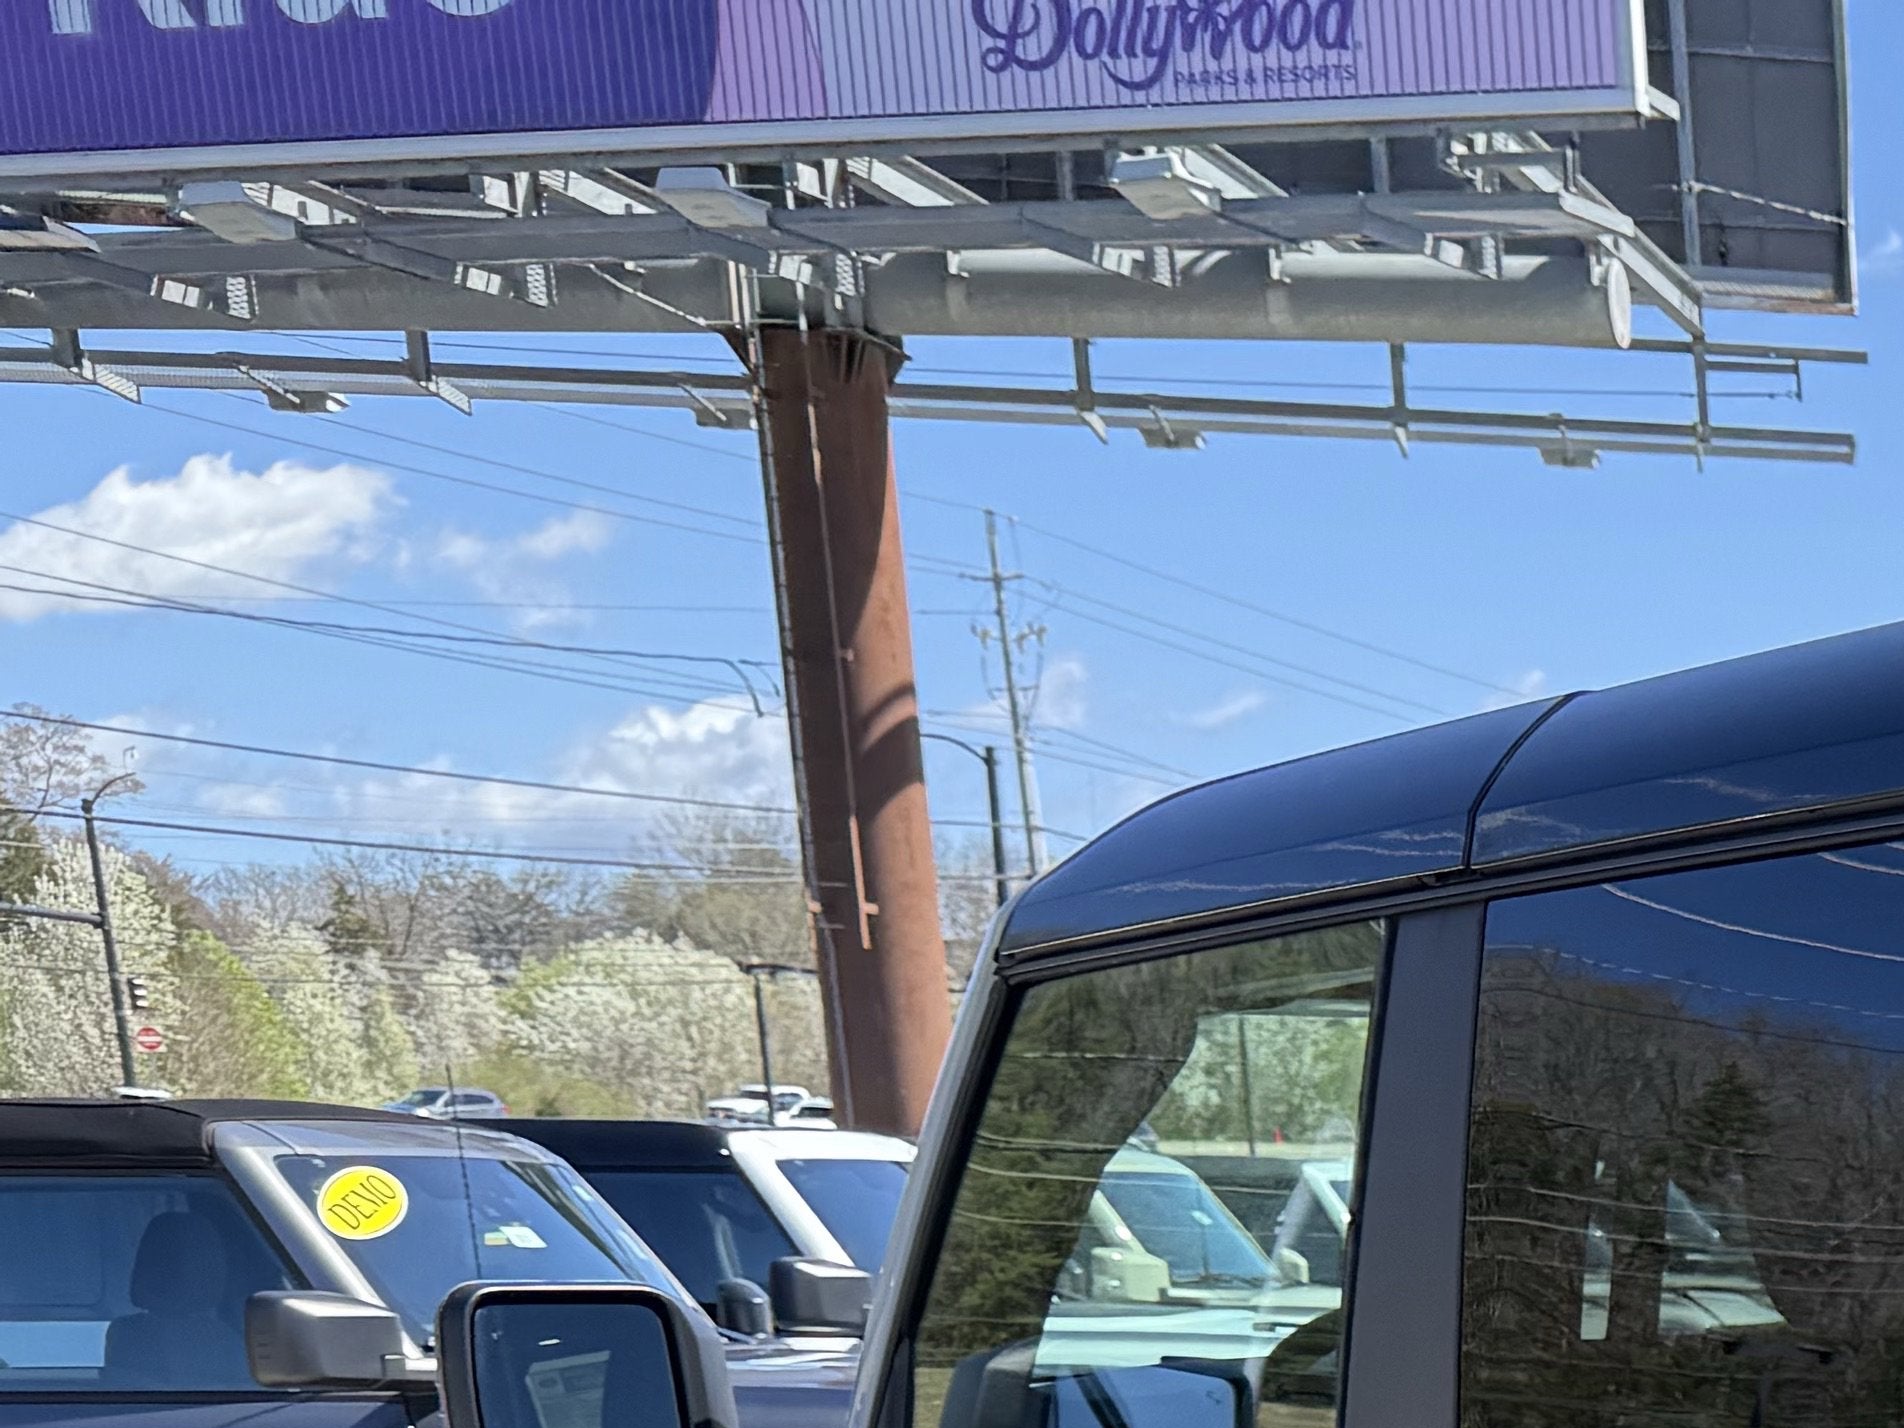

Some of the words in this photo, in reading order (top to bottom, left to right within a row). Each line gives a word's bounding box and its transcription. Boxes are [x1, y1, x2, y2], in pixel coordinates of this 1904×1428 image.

[1175, 65, 1239, 87] PARKS
[1244, 63, 1257, 85] &
[1263, 62, 1357, 84] RESORTS
